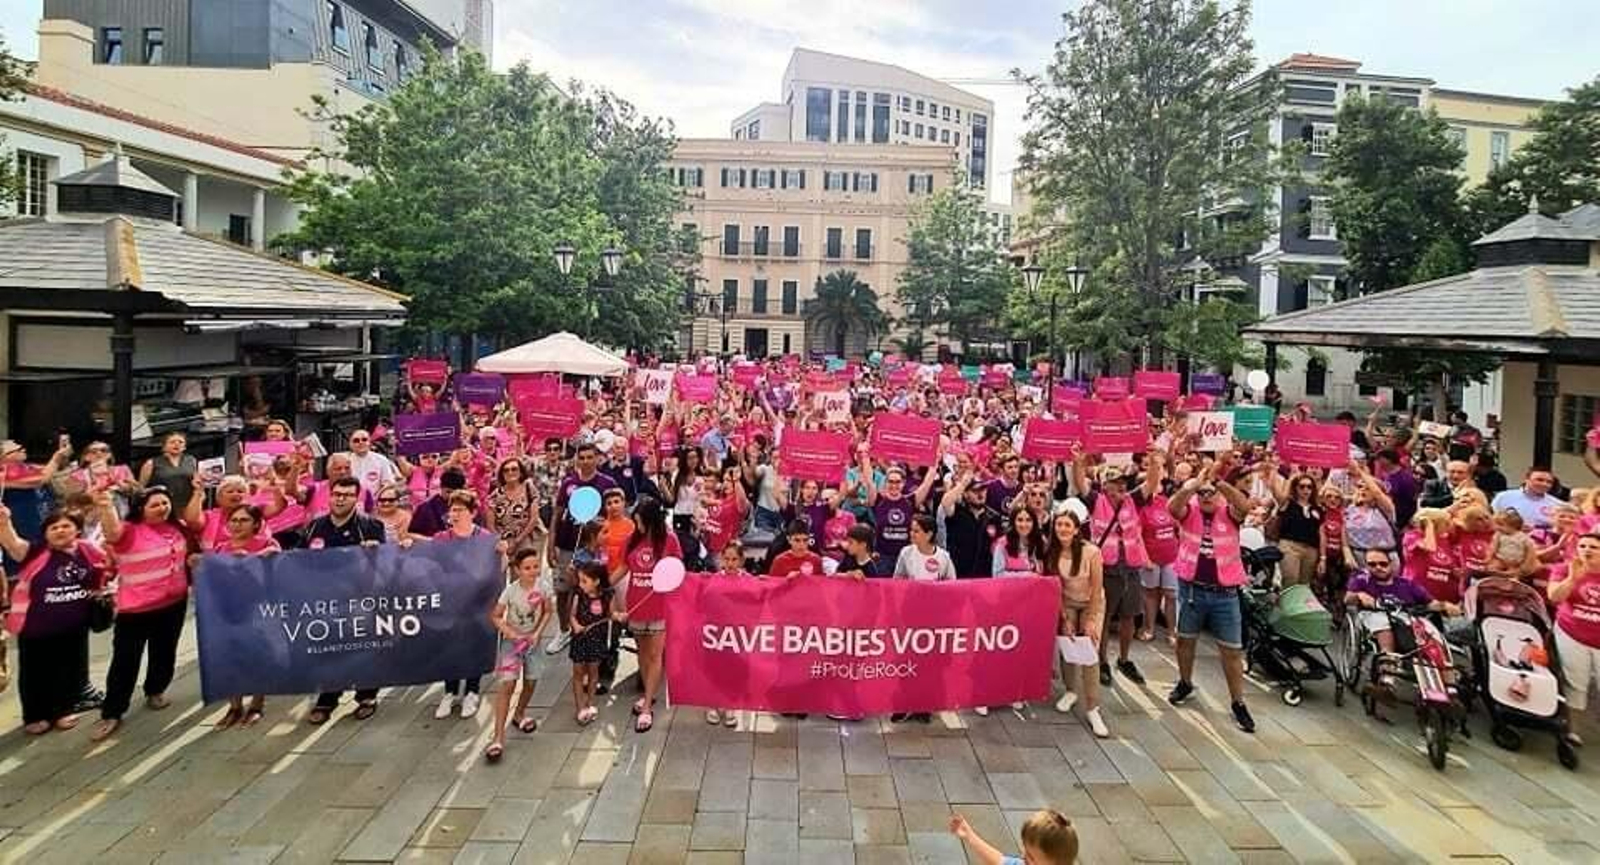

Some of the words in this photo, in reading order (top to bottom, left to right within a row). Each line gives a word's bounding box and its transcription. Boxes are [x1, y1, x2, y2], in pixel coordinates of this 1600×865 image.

[258, 603, 290, 619] WE
[300, 600, 339, 616] ARE
[349, 597, 389, 614] FOR
[393, 593, 442, 611] LIFE
[282, 616, 366, 643] VOTE
[374, 614, 421, 637] NO
[702, 624, 776, 653] SAVE
[782, 625, 886, 657] BABIES
[890, 628, 968, 654] VOTE
[973, 624, 1020, 651] NO
